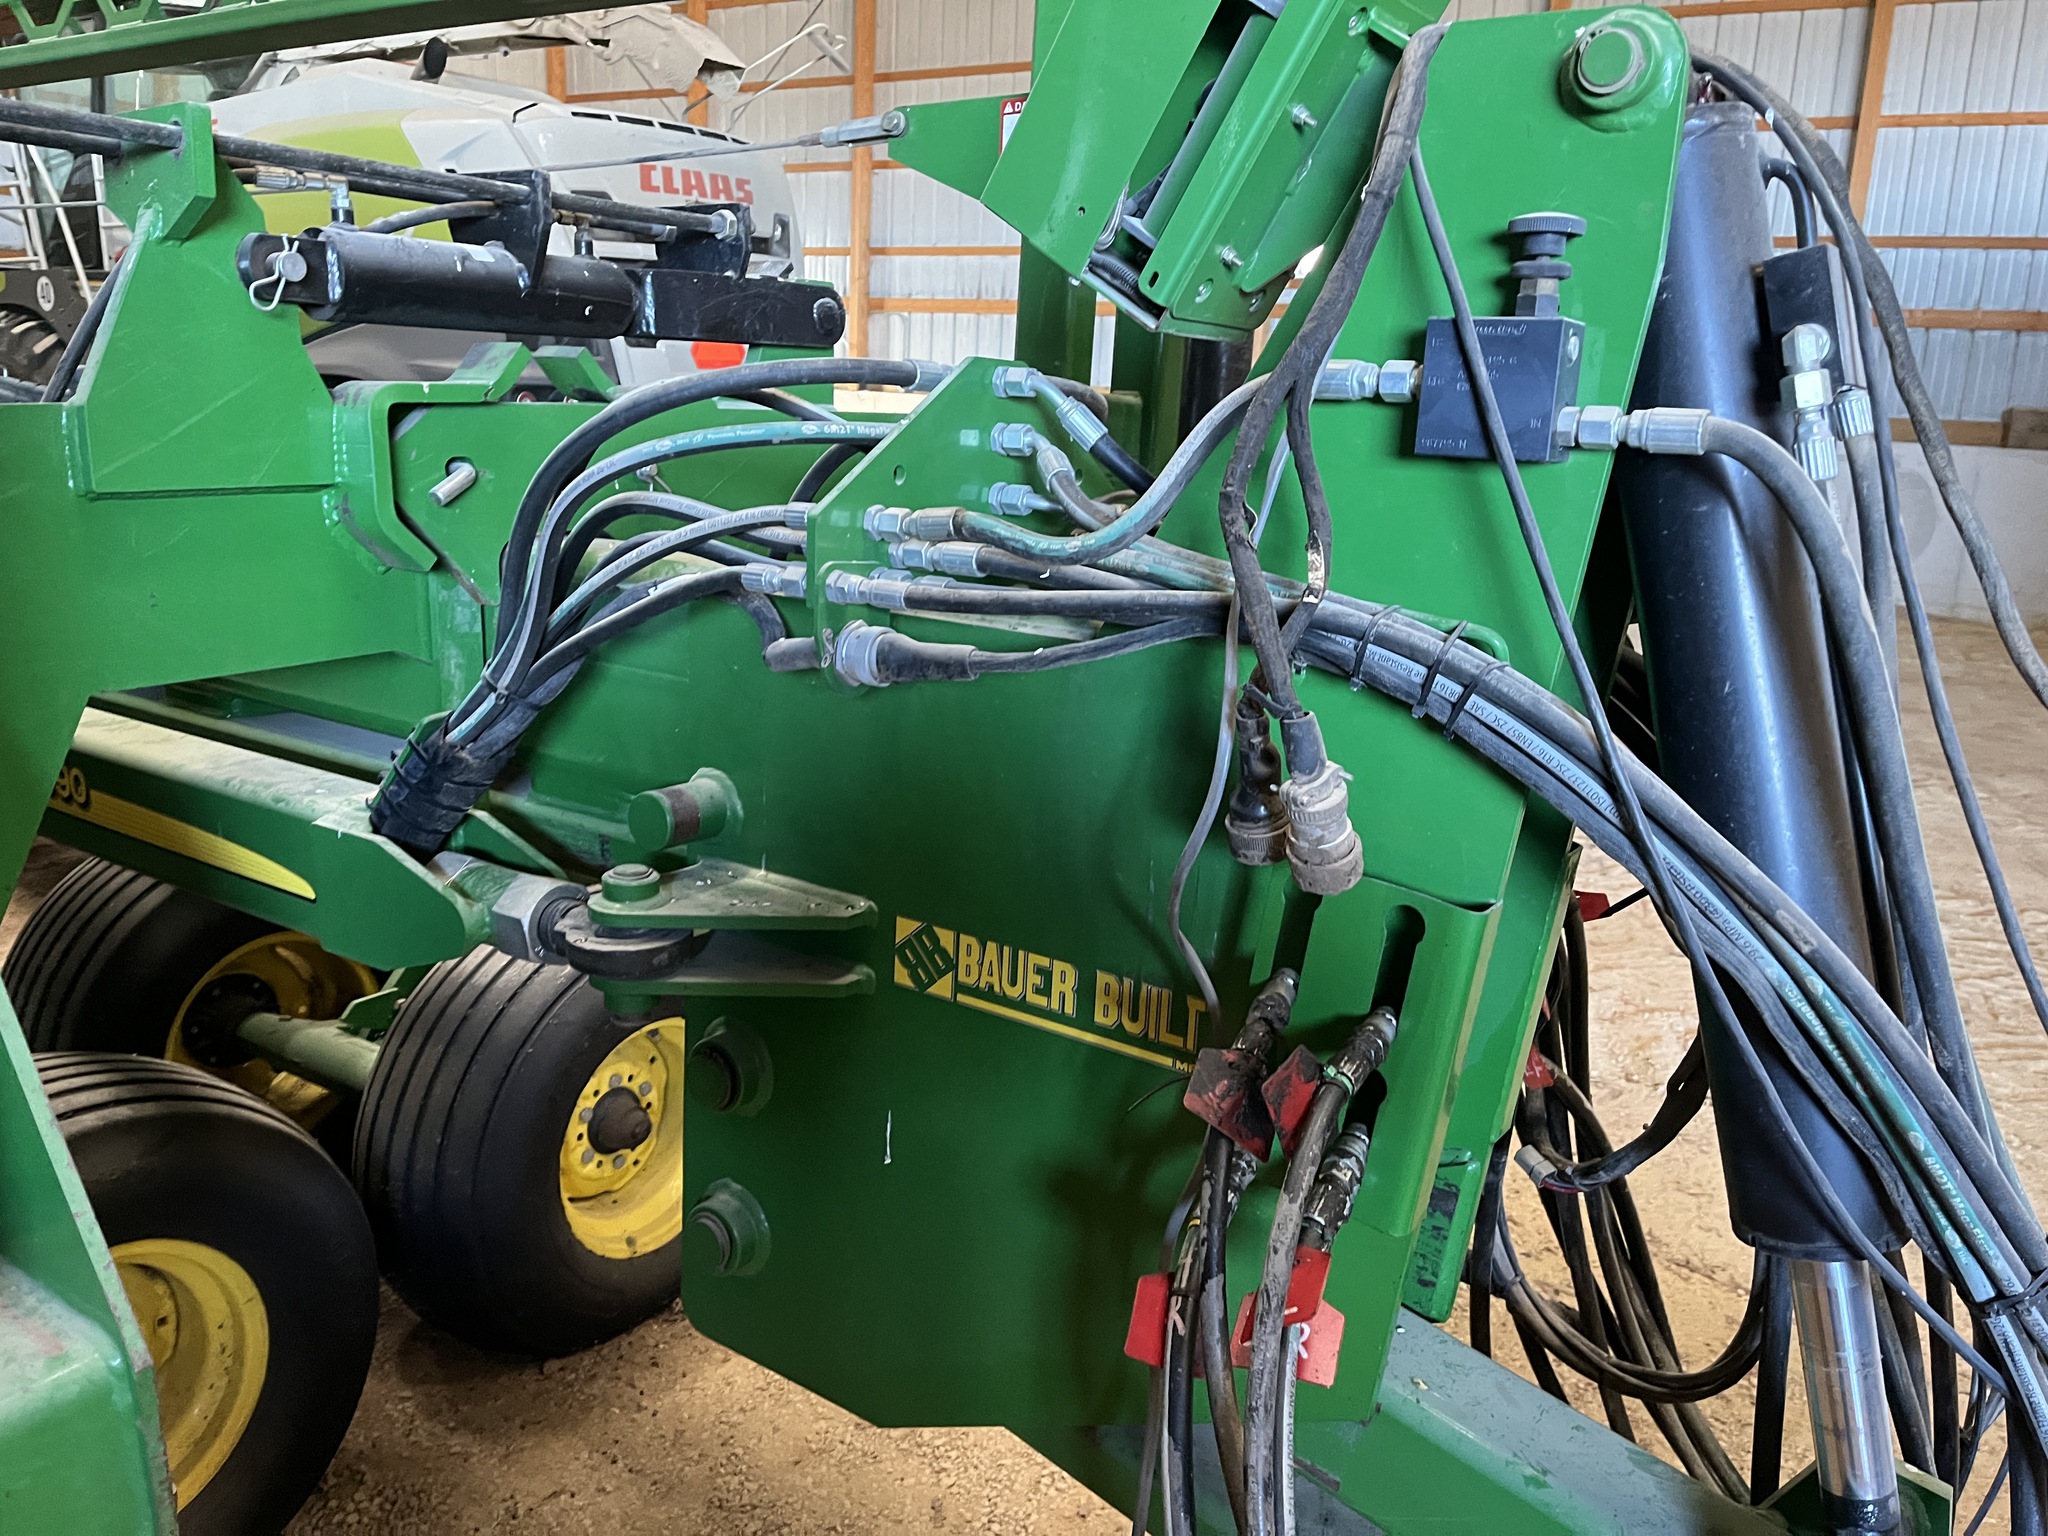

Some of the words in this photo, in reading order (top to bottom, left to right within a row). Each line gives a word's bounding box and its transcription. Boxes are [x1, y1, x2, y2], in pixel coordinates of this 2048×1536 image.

[639, 163, 754, 205] CLAAS
[1468, 700, 1488, 716] SAE
[957, 932, 1079, 1018] BAUER
[1094, 968, 1207, 1054] BUILT
